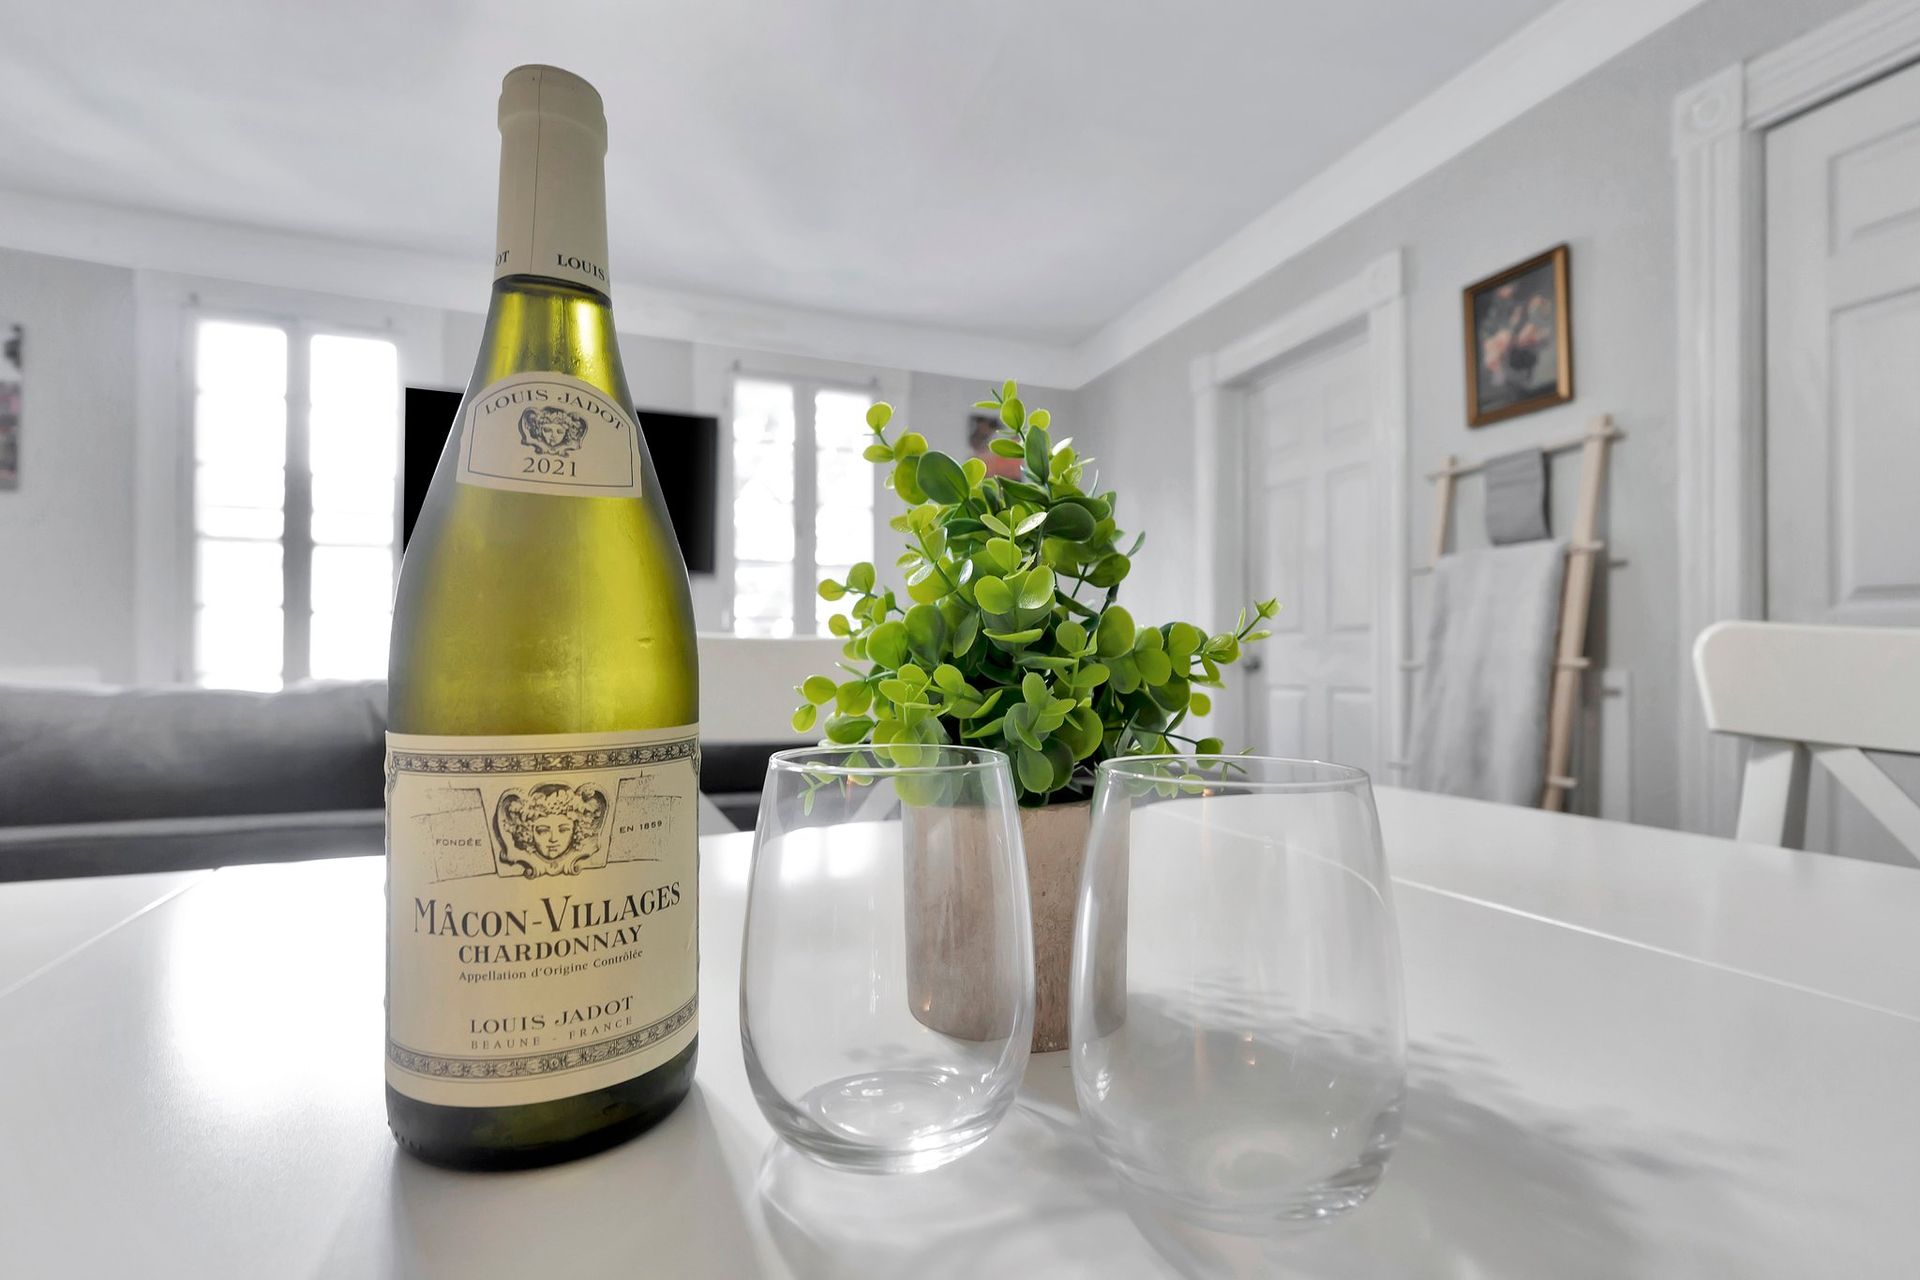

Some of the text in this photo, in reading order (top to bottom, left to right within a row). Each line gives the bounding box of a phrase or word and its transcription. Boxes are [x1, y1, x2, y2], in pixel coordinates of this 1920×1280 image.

[557, 254, 605, 281] LOUIS
[484, 389, 625, 430] LOUIS JADOT
[522, 457, 578, 477] 2021
[435, 837, 482, 847] FONDÉE
[619, 825, 634, 834] EN
[458, 924, 643, 964] CHARDONNAY
[459, 970, 527, 983] Appellation
[593, 948, 643, 969] Contrôlée
[469, 996, 634, 1035] LOUIS JADOT
[471, 1036, 541, 1050] BEAUNE
[569, 1016, 633, 1040] FRANCE
